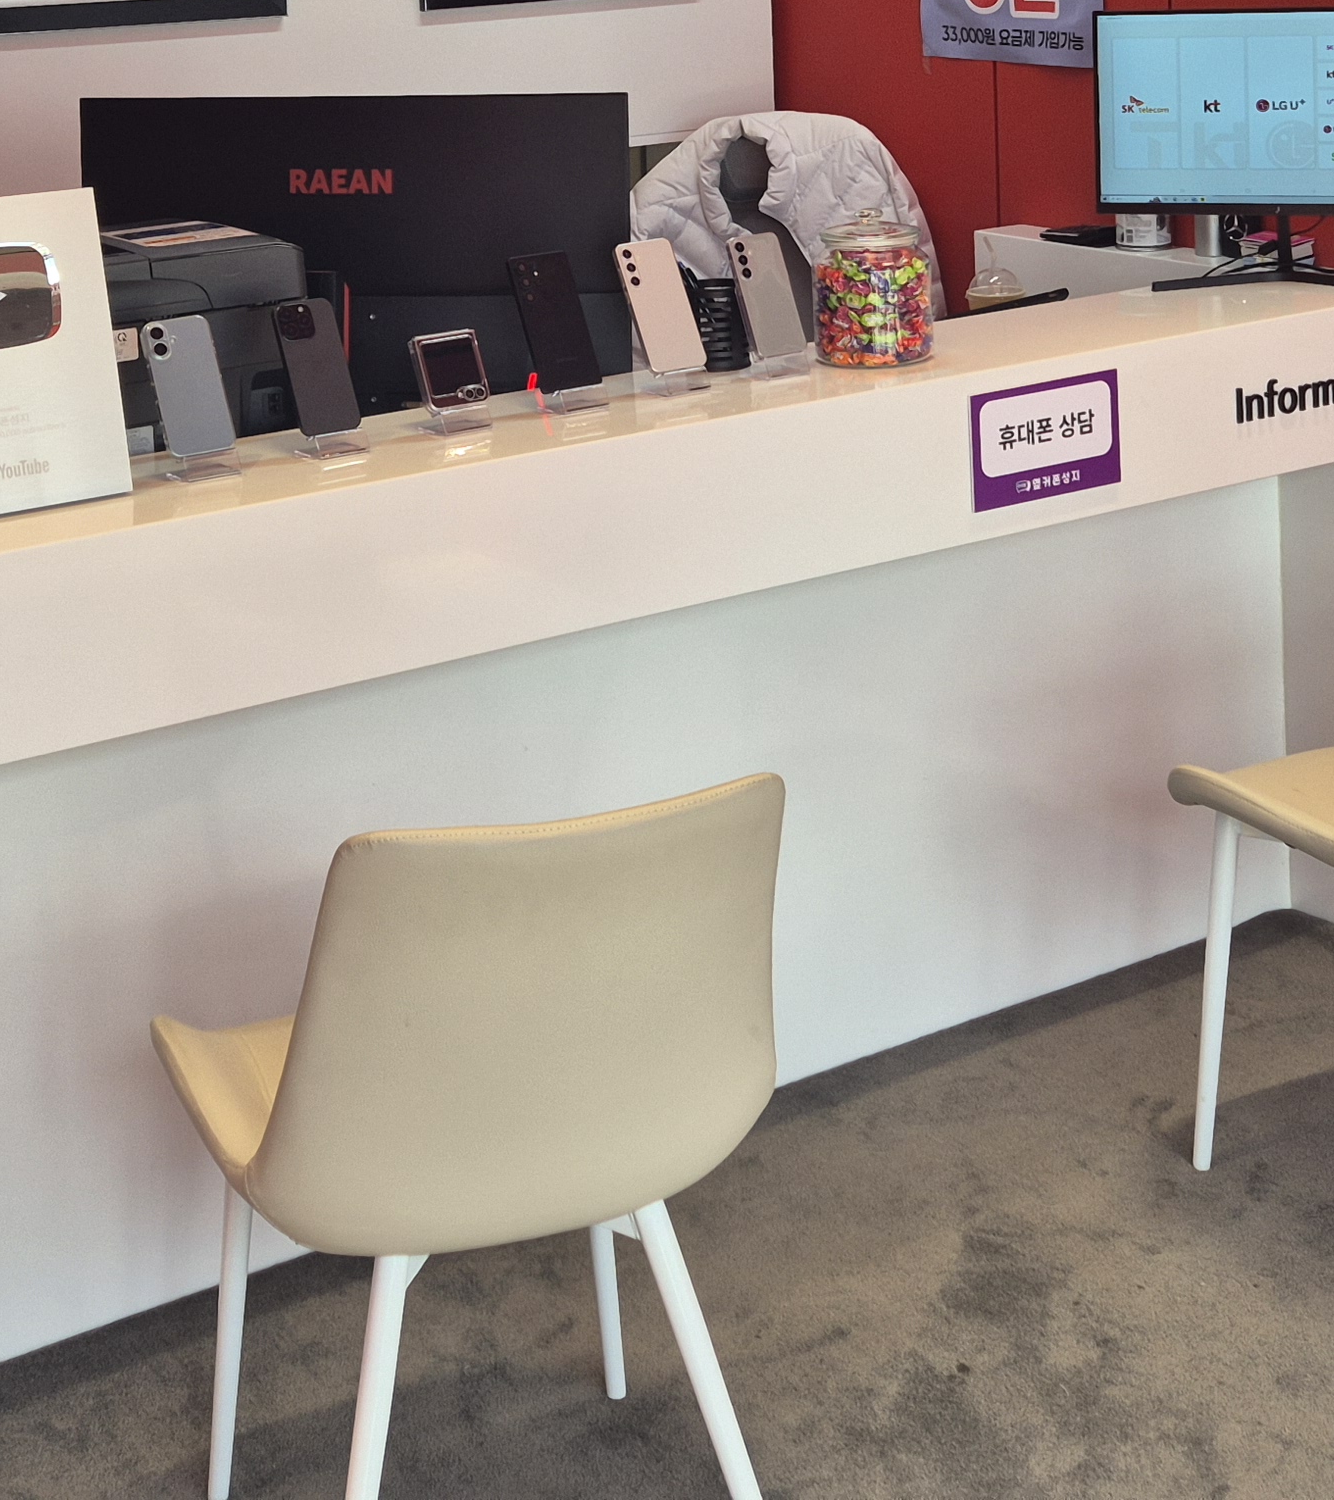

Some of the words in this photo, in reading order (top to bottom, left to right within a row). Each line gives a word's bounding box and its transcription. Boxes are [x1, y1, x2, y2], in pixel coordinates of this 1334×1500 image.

[941, 25, 996, 46] 33,000원
[998, 28, 1035, 47] 요금제
[1038, 30, 1085, 51] 가입가능
[1121, 104, 1135, 113] SK
[1203, 99, 1221, 113] kt
[1272, 100, 1288, 111] LG
[1290, 99, 1306, 111] U+
[289, 168, 393, 194] RAEAN
[998, 417, 1054, 451] 휴대폰
[1059, 408, 1095, 438] 상담
